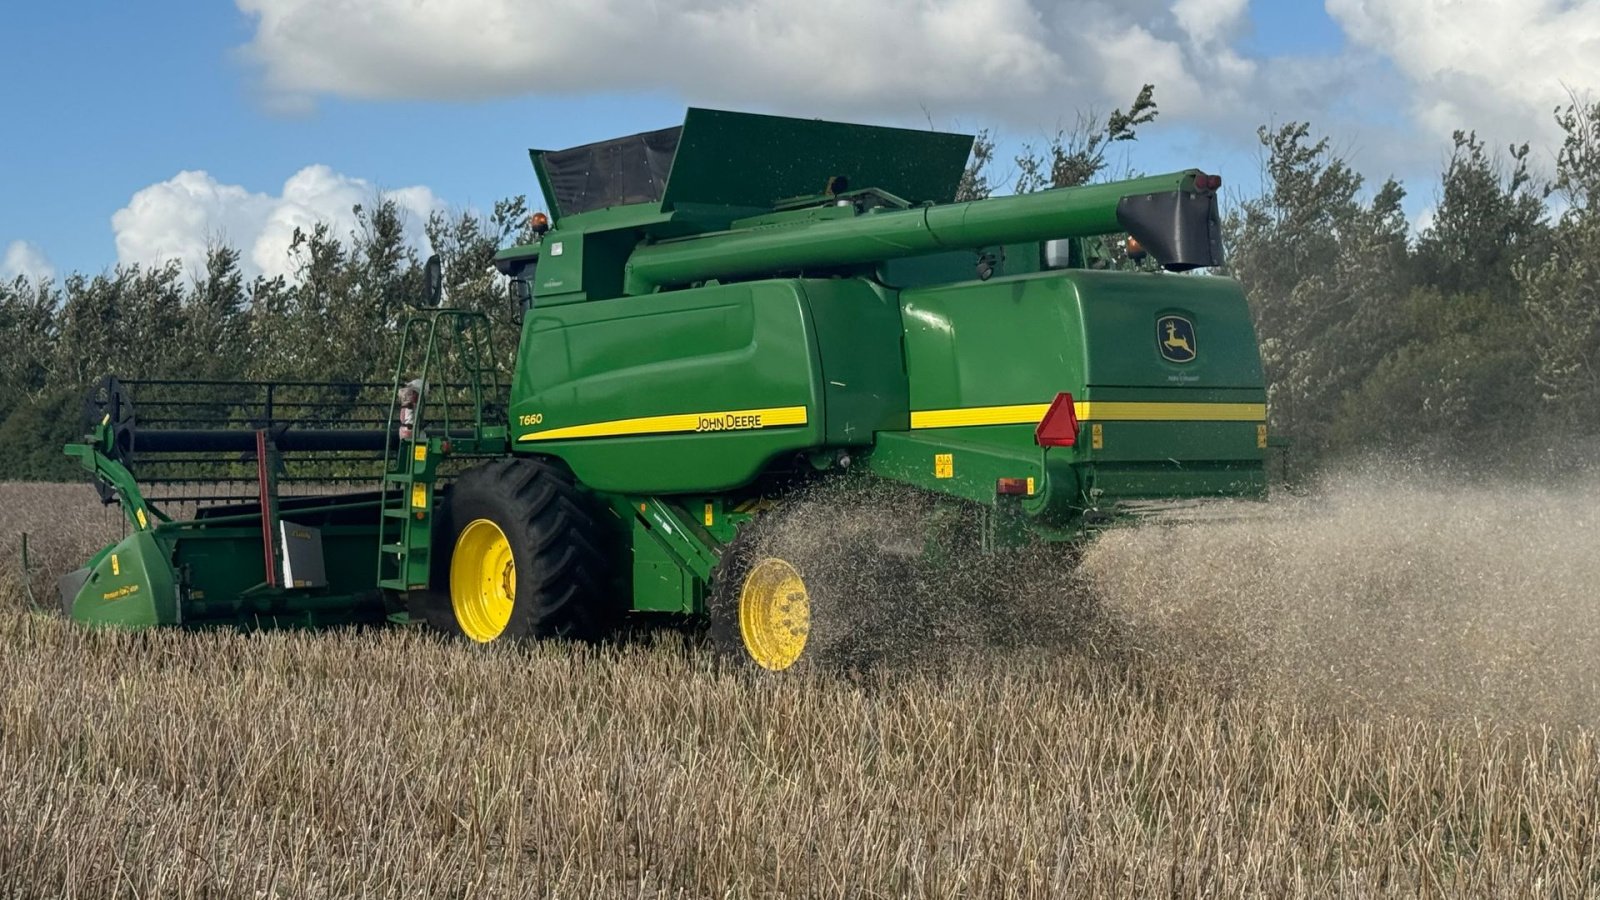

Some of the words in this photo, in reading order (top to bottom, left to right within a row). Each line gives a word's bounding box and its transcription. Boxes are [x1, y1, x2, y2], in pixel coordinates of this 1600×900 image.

[519, 413, 543, 426] T660
[696, 416, 724, 430] JOHN
[726, 414, 762, 428] DEERE
